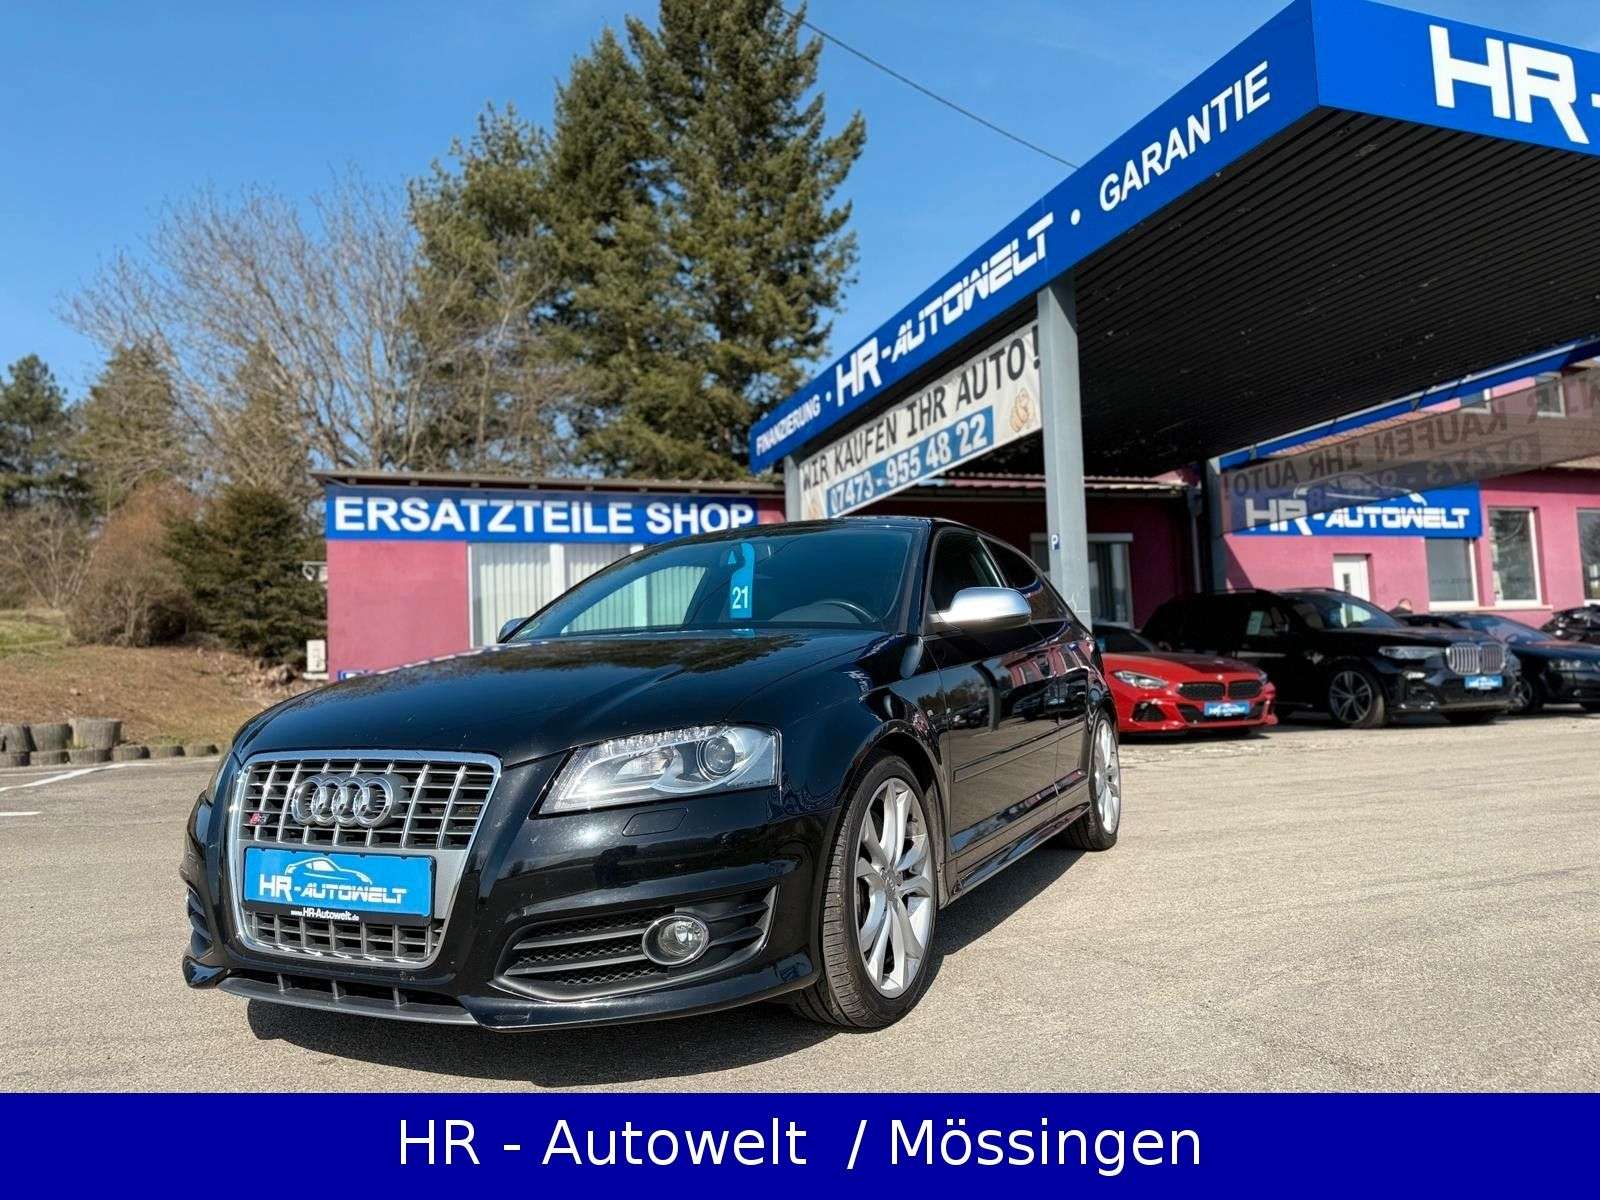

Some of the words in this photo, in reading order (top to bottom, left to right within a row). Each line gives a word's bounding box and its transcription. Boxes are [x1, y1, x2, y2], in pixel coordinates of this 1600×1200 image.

[1099, 60, 1271, 212] GARANTIE
[803, 451, 830, 492] WIR
[834, 413, 898, 476] KAUFEN
[907, 385, 947, 438] IHR
[956, 325, 1040, 411] AUTO!
[334, 496, 634, 534] ERSATZTEILE
[645, 502, 755, 534] SHOP
[831, 470, 875, 515] 07473
[886, 449, 922, 490] 955
[925, 431, 952, 469] 48
[956, 412, 988, 454] 22
[732, 586, 749, 609] 21
